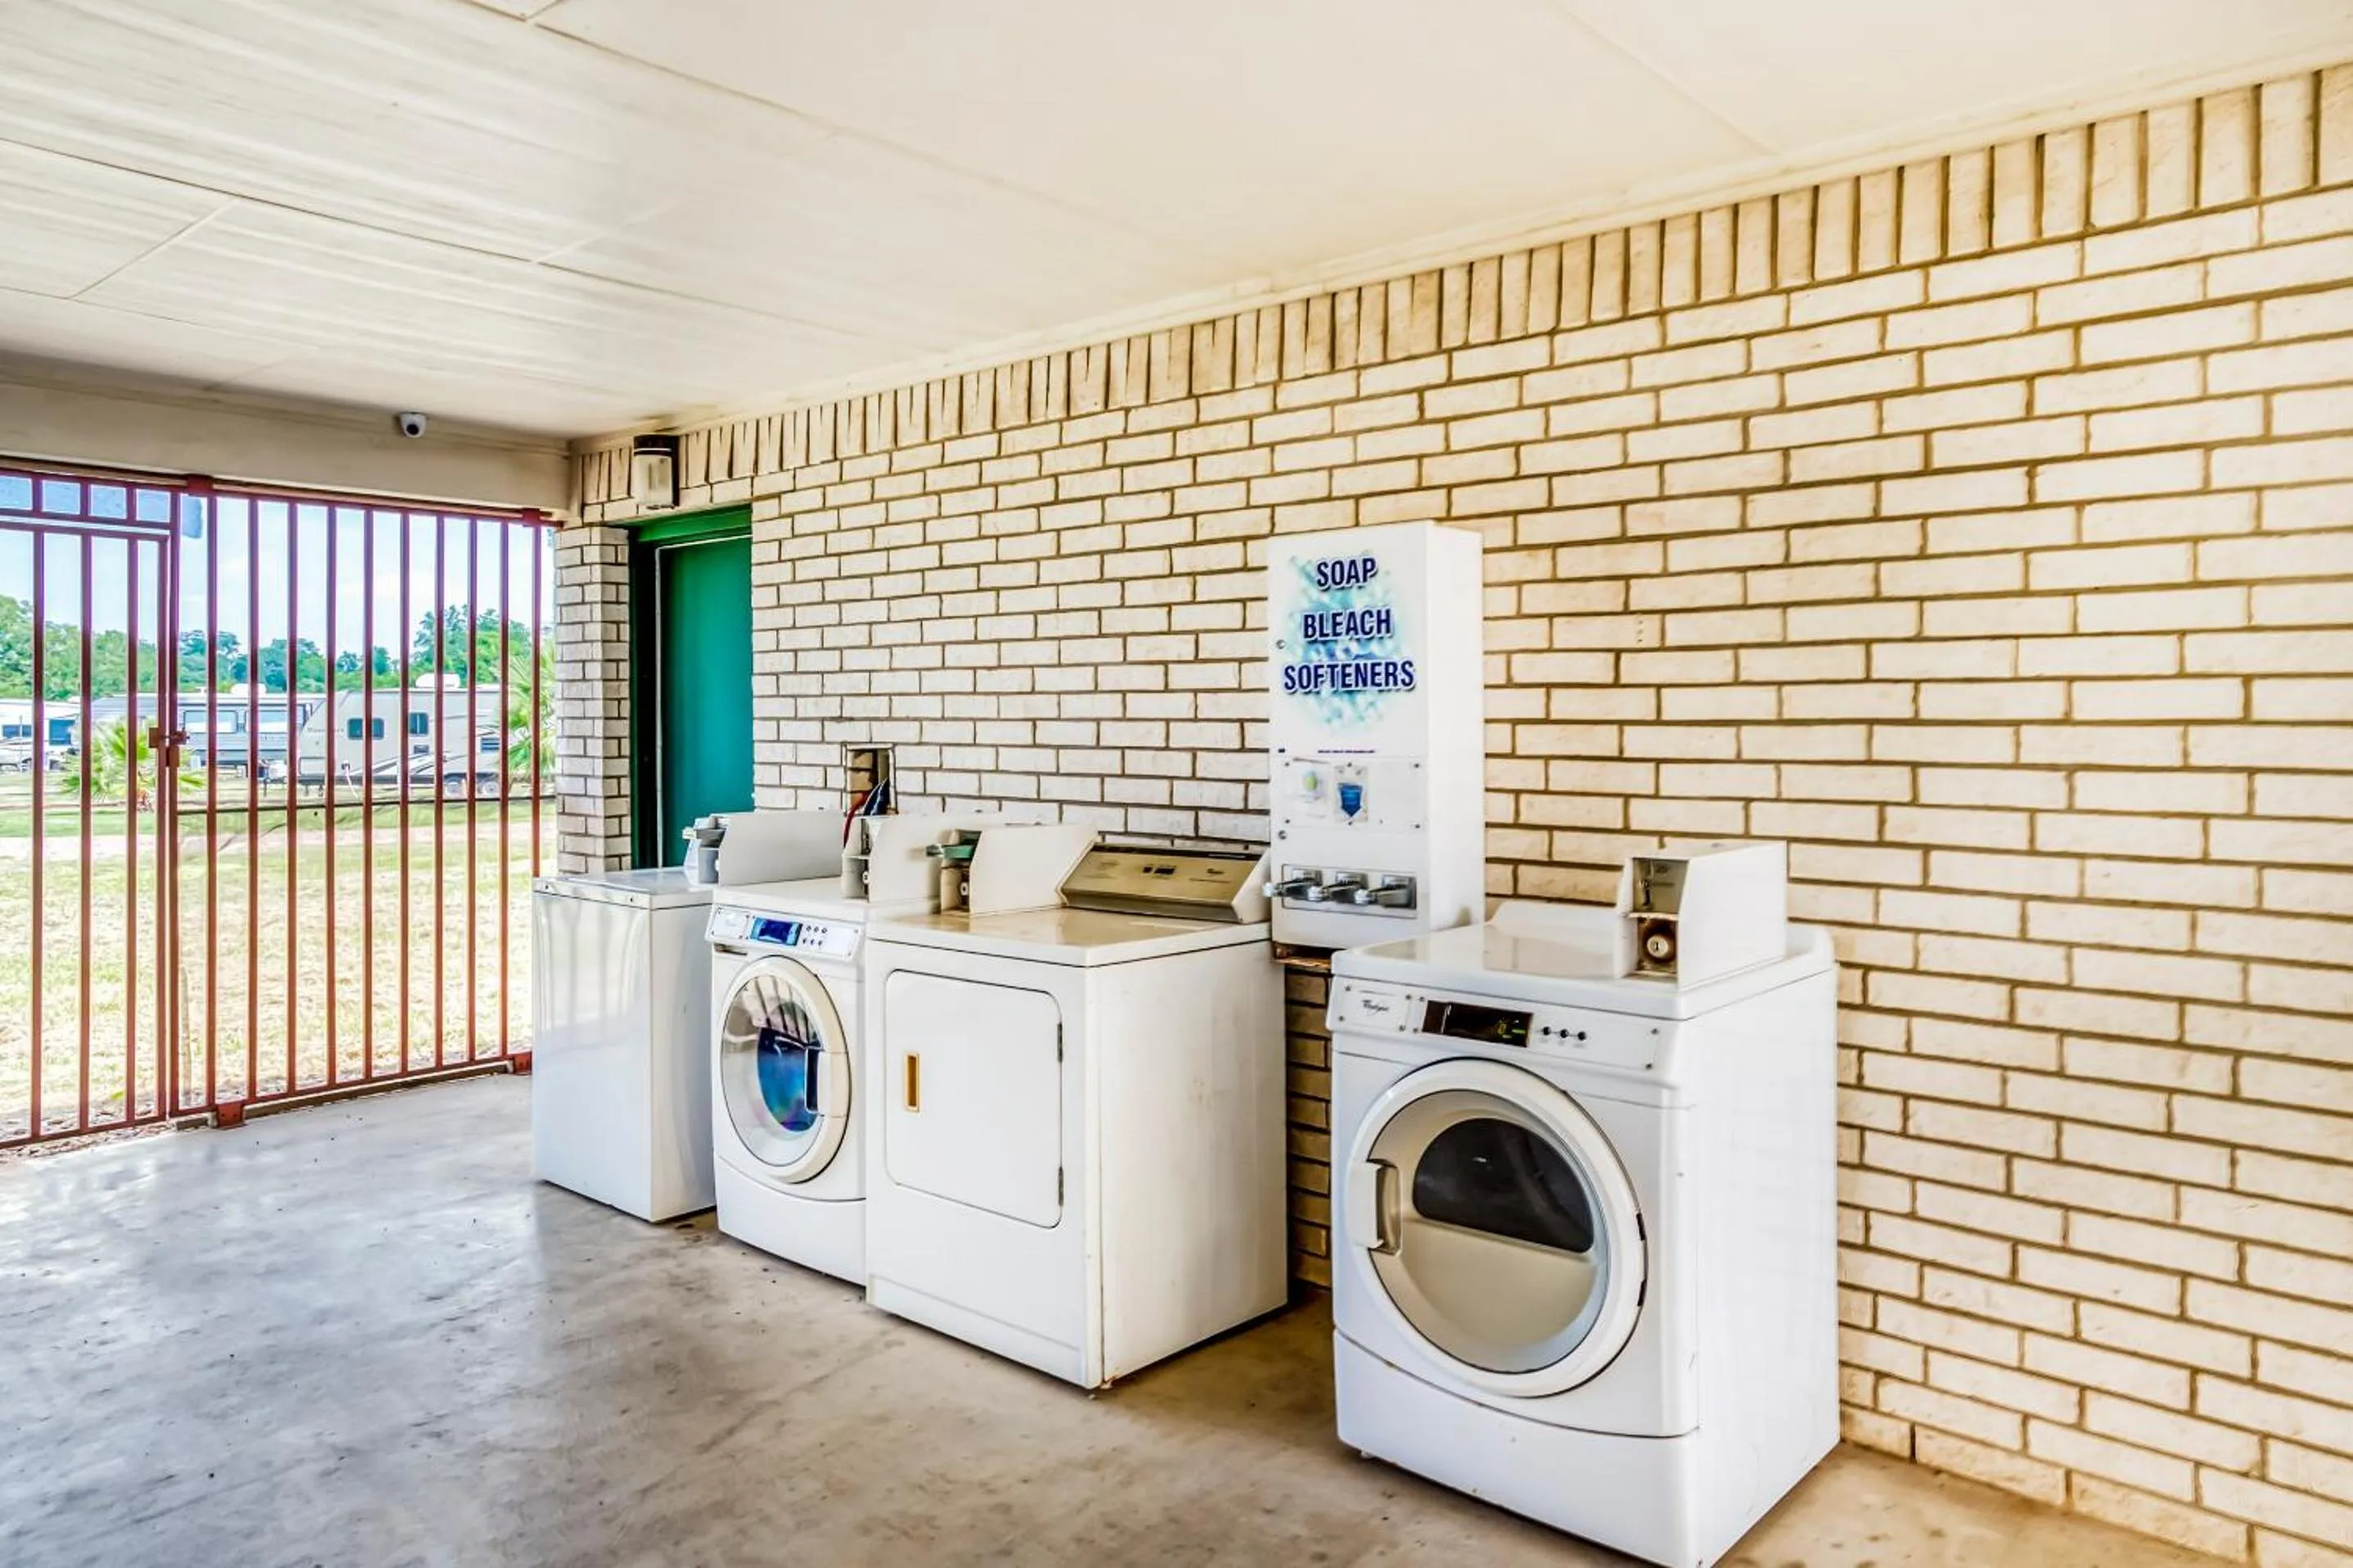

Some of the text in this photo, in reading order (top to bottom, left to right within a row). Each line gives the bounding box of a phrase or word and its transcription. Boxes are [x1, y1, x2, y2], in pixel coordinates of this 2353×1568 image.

[1316, 557, 1377, 588] SOAP
[1303, 608, 1391, 639] BLEACH
[1283, 660, 1414, 691] SOFTENERS
